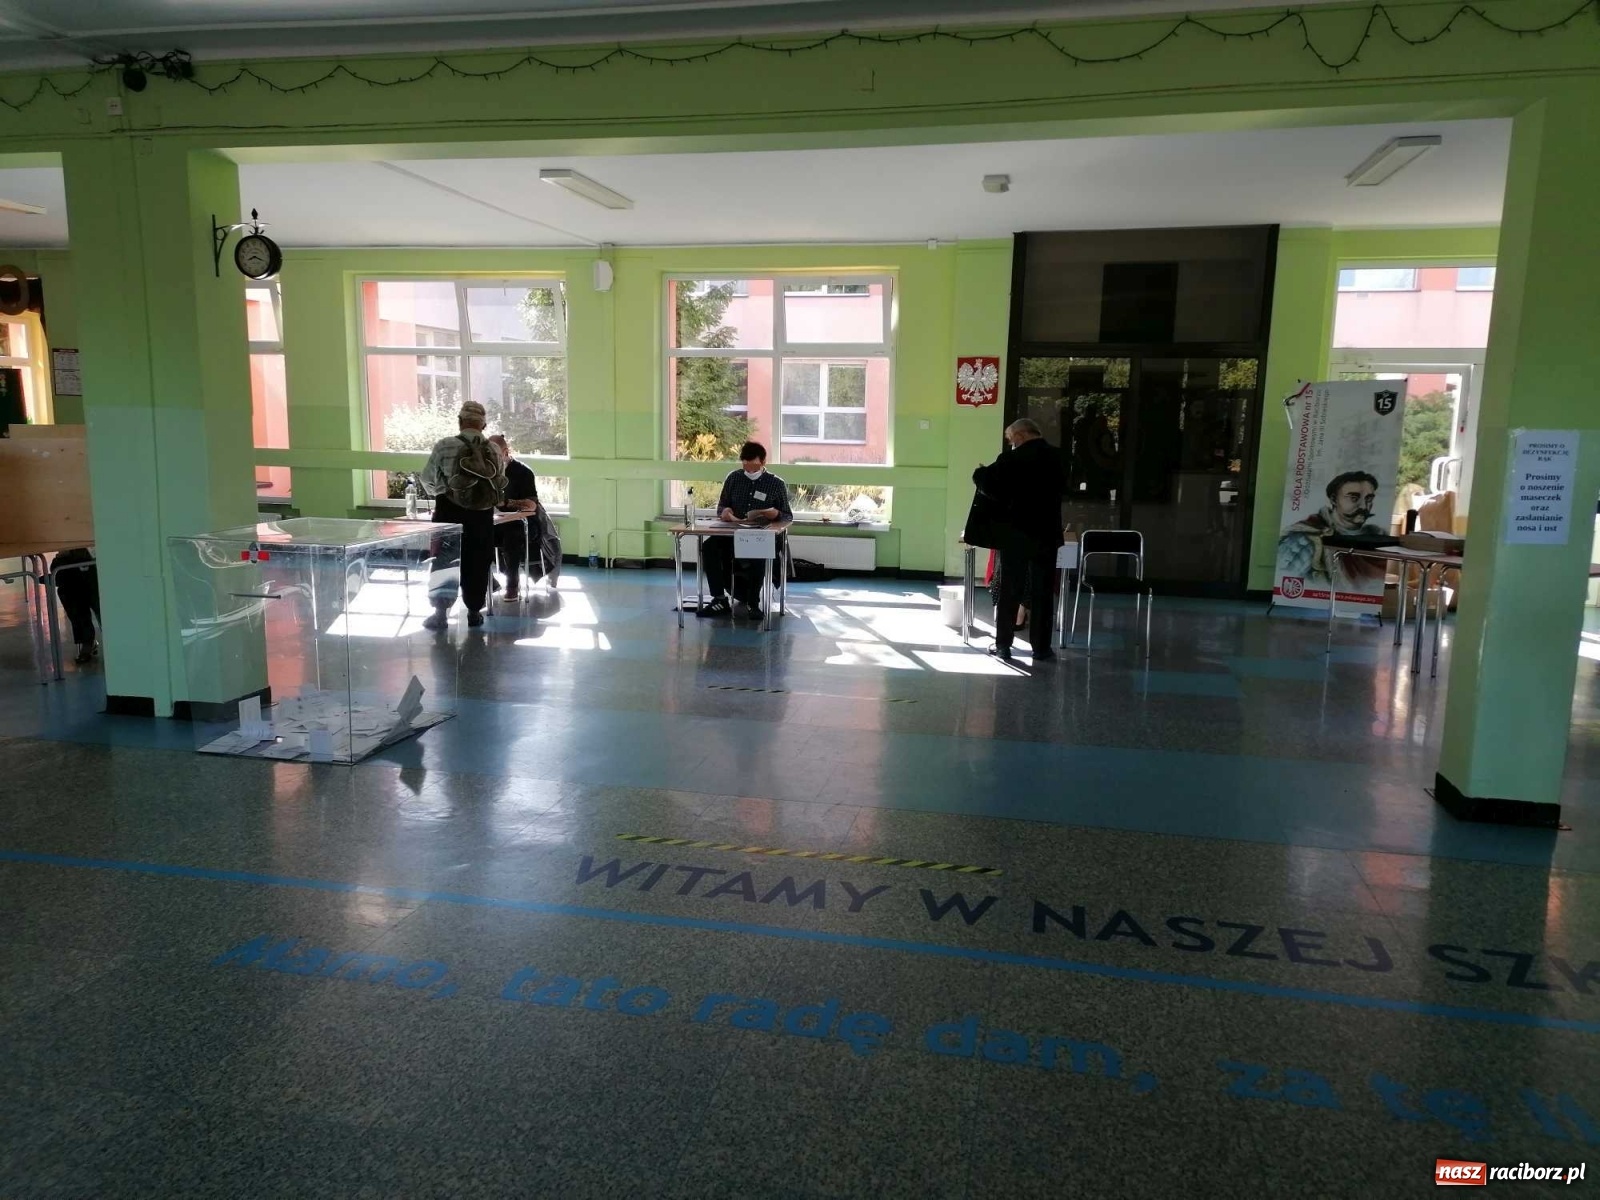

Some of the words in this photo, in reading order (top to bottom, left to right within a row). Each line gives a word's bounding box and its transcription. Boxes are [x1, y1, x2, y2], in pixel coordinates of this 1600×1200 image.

[1304, 389, 1314, 399] 15
[1377, 398, 1392, 409] 15
[1296, 413, 1311, 476] PODSTAWOWA
[1291, 475, 1303, 512] SZKOŁA
[1525, 473, 1562, 482] Prosimy
[574, 855, 892, 913] WITAMY
[919, 888, 1001, 926] W
[1032, 900, 1394, 973] NASZEJ
[501, 965, 670, 1016] tato
[689, 993, 892, 1058] radę
[1218, 1057, 1344, 1111] za
